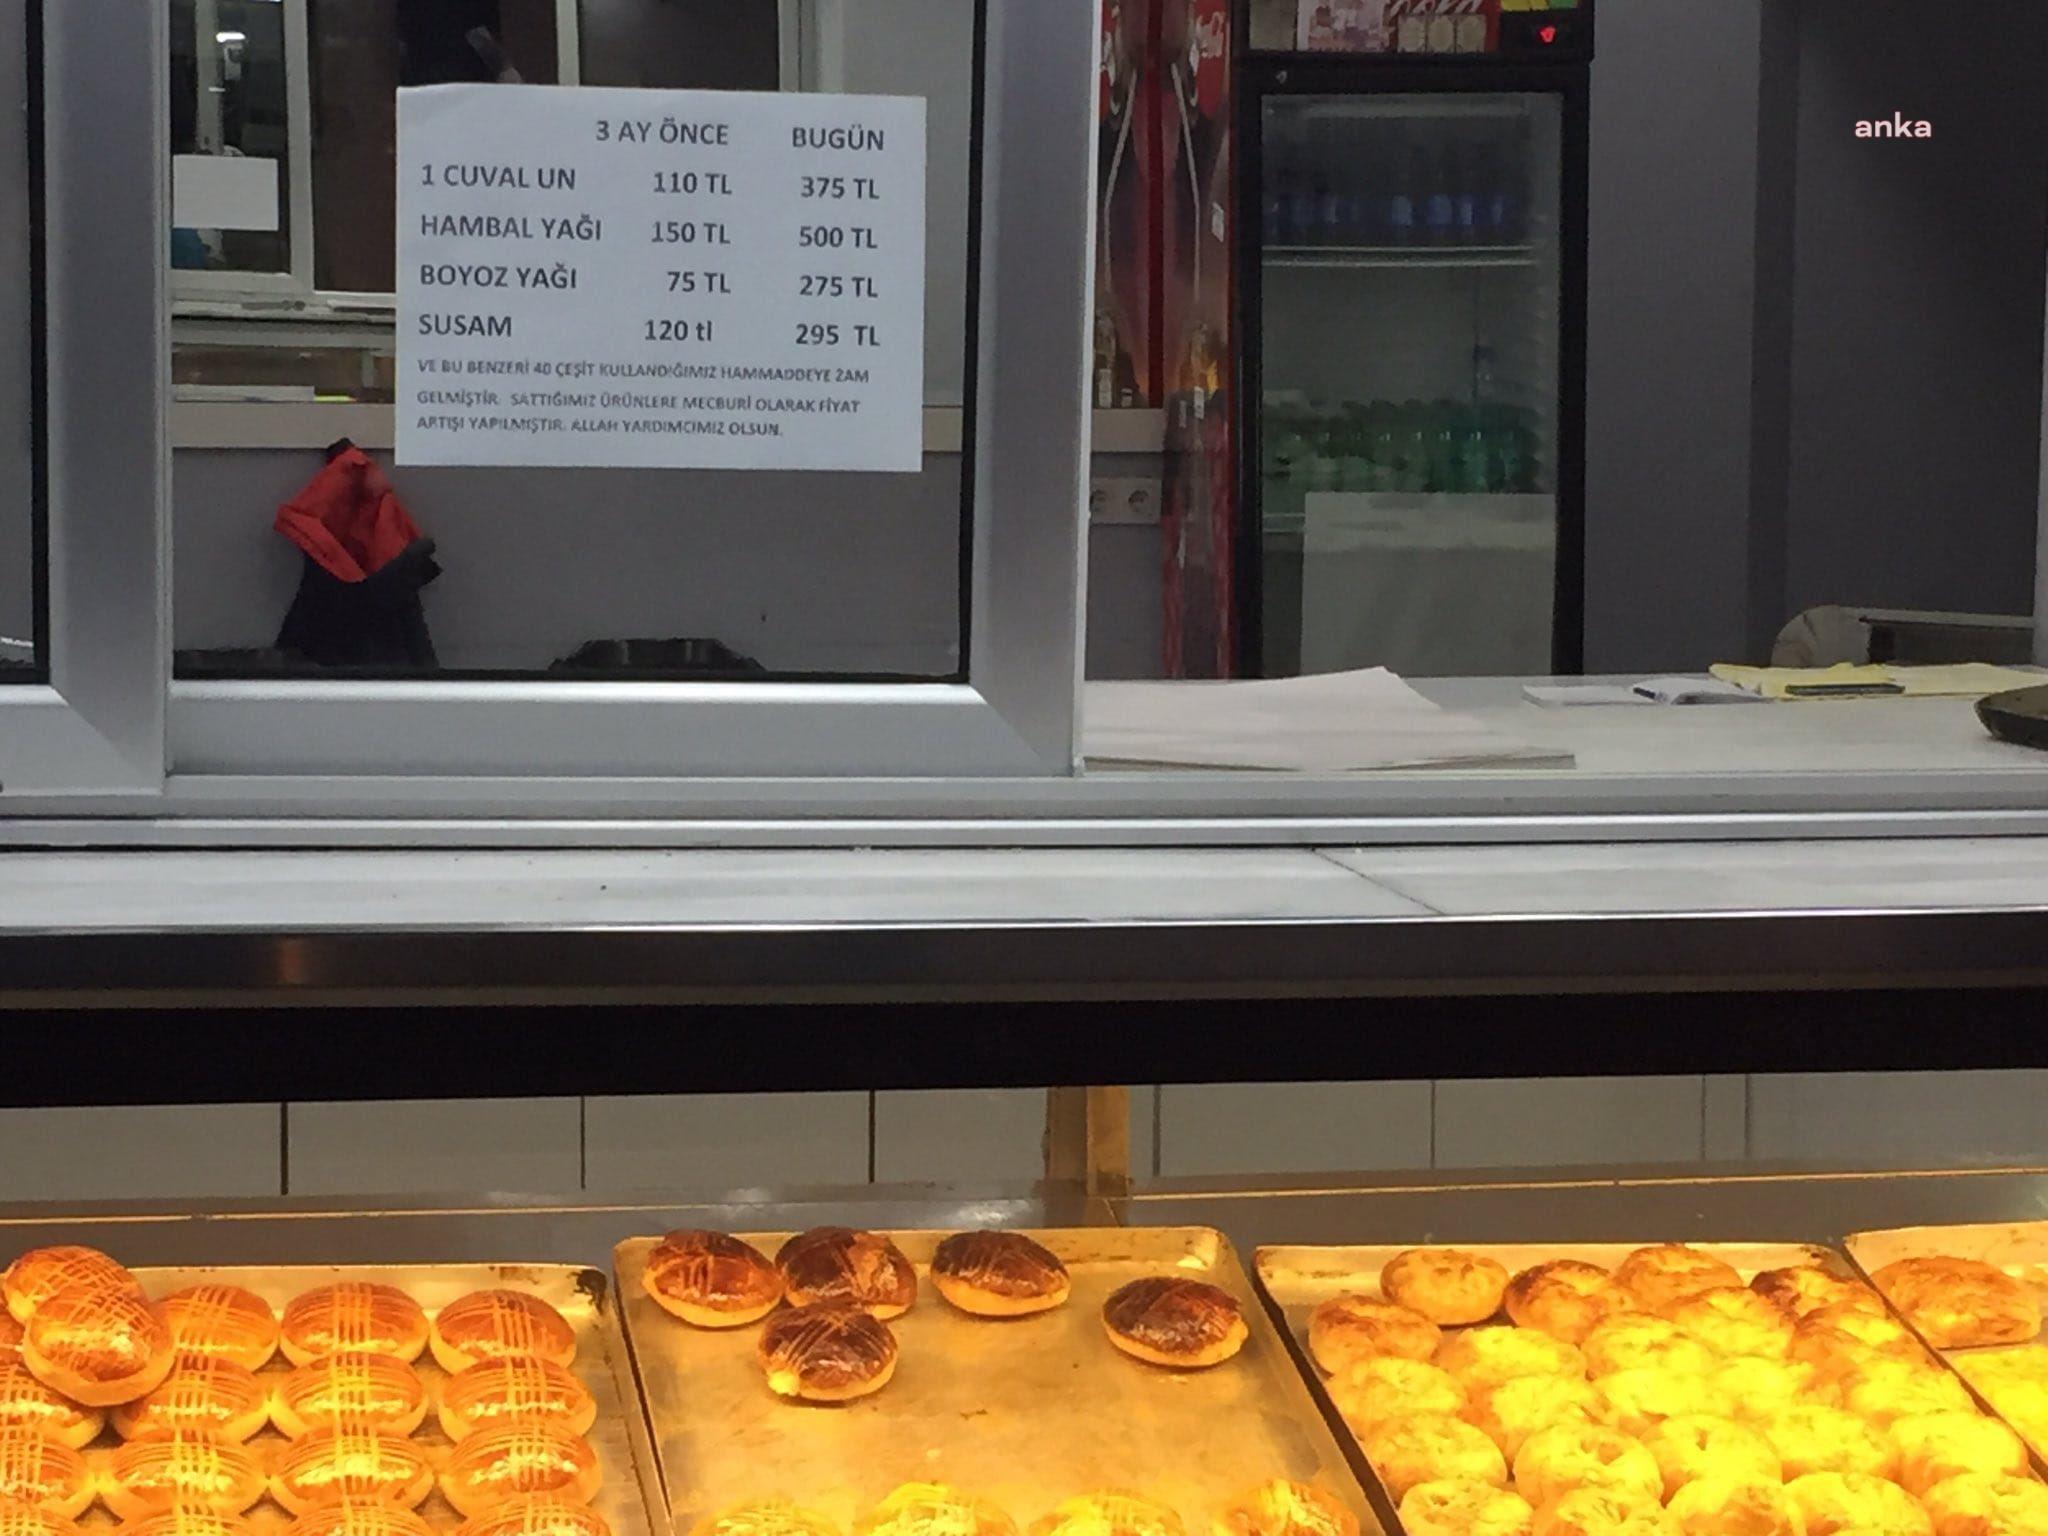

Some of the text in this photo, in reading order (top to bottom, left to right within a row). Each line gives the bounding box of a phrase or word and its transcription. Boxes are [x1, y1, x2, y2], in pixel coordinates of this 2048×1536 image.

[596, 117, 885, 151] 3 AY ÖNCE BUGÜN
[422, 164, 880, 200] 1 CUVAL UN 110 TL 375 TL
[421, 214, 878, 249] HAMBAL YAĞI 150 TL 500 TL
[420, 262, 879, 298] BOYOZ YAĞI 75 TL 275 TL
[418, 313, 881, 347] SUSAM 120 tl 295 TL
[417, 359, 437, 373] VE
[441, 359, 463, 374] BU
[467, 359, 530, 375] BENZERİ
[533, 362, 552, 376] 40
[555, 361, 596, 379] ÇEŞİT
[720, 366, 832, 383] HAMMADDEYE
[835, 367, 870, 383] ZAM
[510, 391, 596, 408] SATTIĞIMIZ
[600, 391, 678, 409] ÜRÜNLERE
[682, 395, 752, 410] MECBURİ
[755, 399, 815, 413] OLARAK
[818, 396, 861, 413] FİYAT
[571, 419, 618, 433] ALLAH
